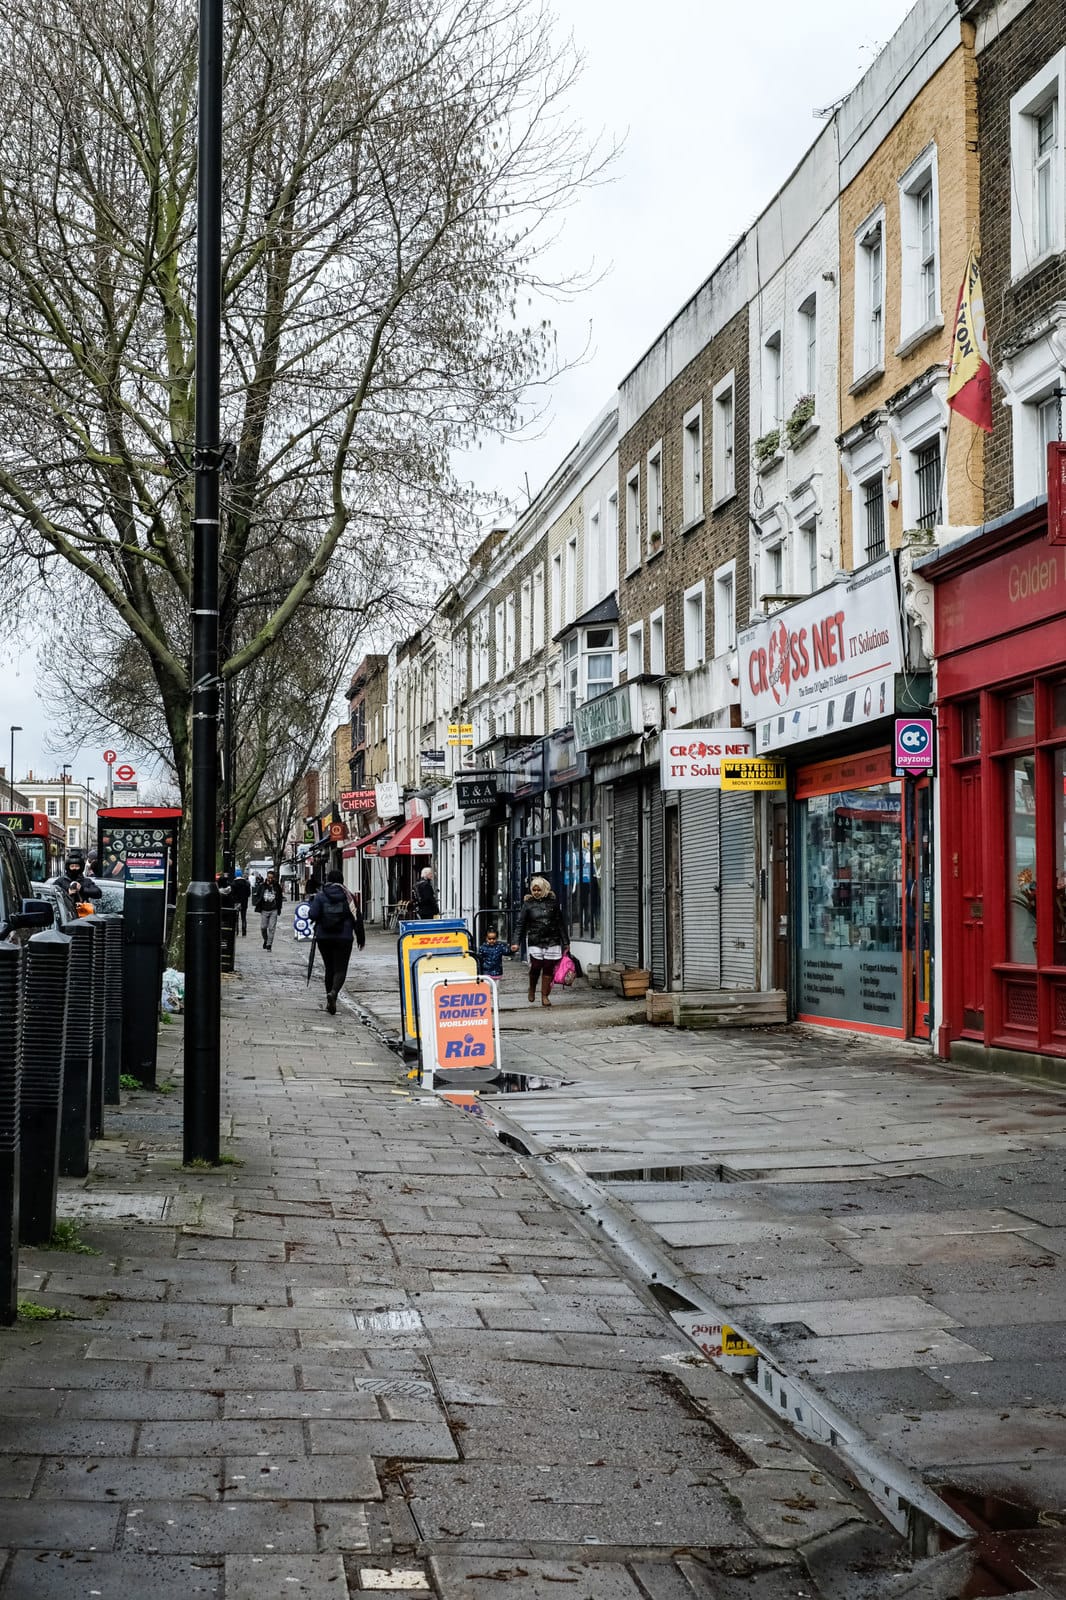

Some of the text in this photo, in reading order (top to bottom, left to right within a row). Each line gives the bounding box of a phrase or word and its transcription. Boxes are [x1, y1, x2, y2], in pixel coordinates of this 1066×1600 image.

[1008, 556, 1057, 603] Golden
[812, 610, 846, 673] NET
[849, 635, 858, 659] IT
[858, 628, 890, 655] Solutions
[725, 744, 750, 755] NET
[107, 752, 114, 761] P
[897, 756, 931, 765] payzone
[671, 765, 687, 776] IT
[725, 763, 774, 771] WESTERN
[462, 785, 492, 797] E & A
[342, 799, 376, 810] CHEMIS
[7, 817, 23, 830] 274
[418, 935, 452, 945] DHL
[438, 992, 487, 1009] SEND
[439, 1008, 487, 1020] MONEY
[439, 1018, 489, 1029] WORLDWIDE
[444, 1033, 486, 1059] Ria
